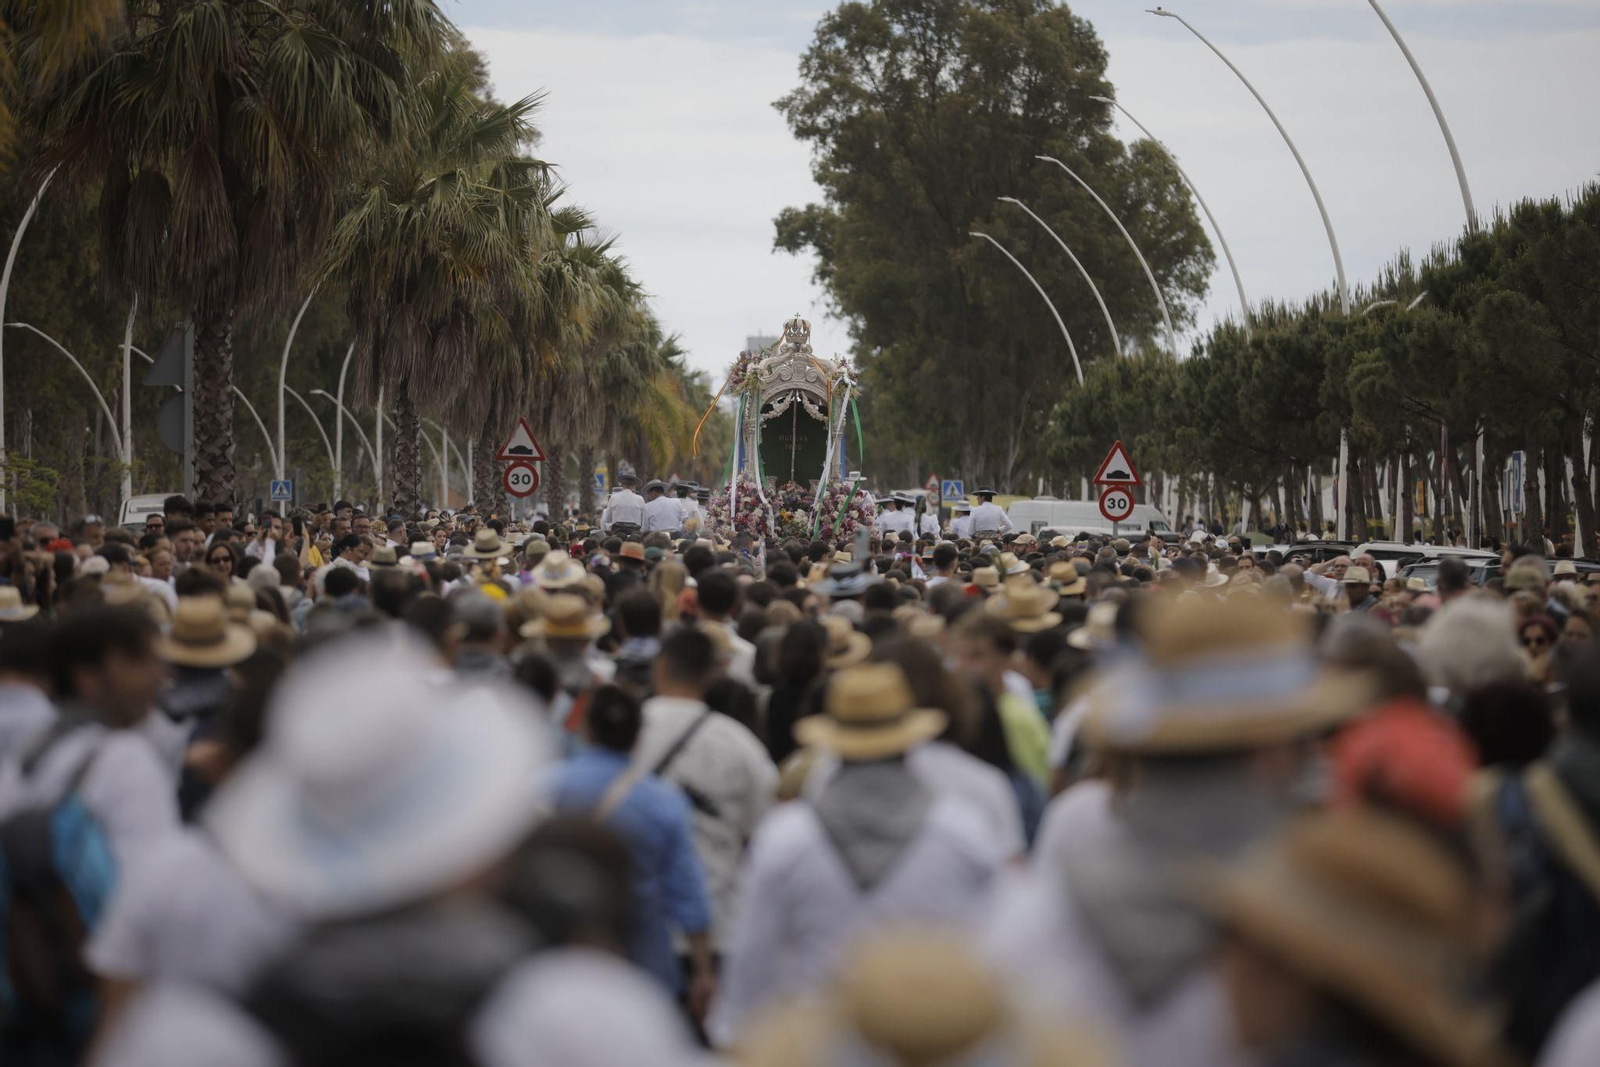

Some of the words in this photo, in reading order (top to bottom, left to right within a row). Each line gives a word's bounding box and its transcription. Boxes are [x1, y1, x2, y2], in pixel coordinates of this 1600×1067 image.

[779, 434, 808, 442] HUEVA
[511, 473, 531, 485] 30
[1107, 498, 1127, 509] 30
